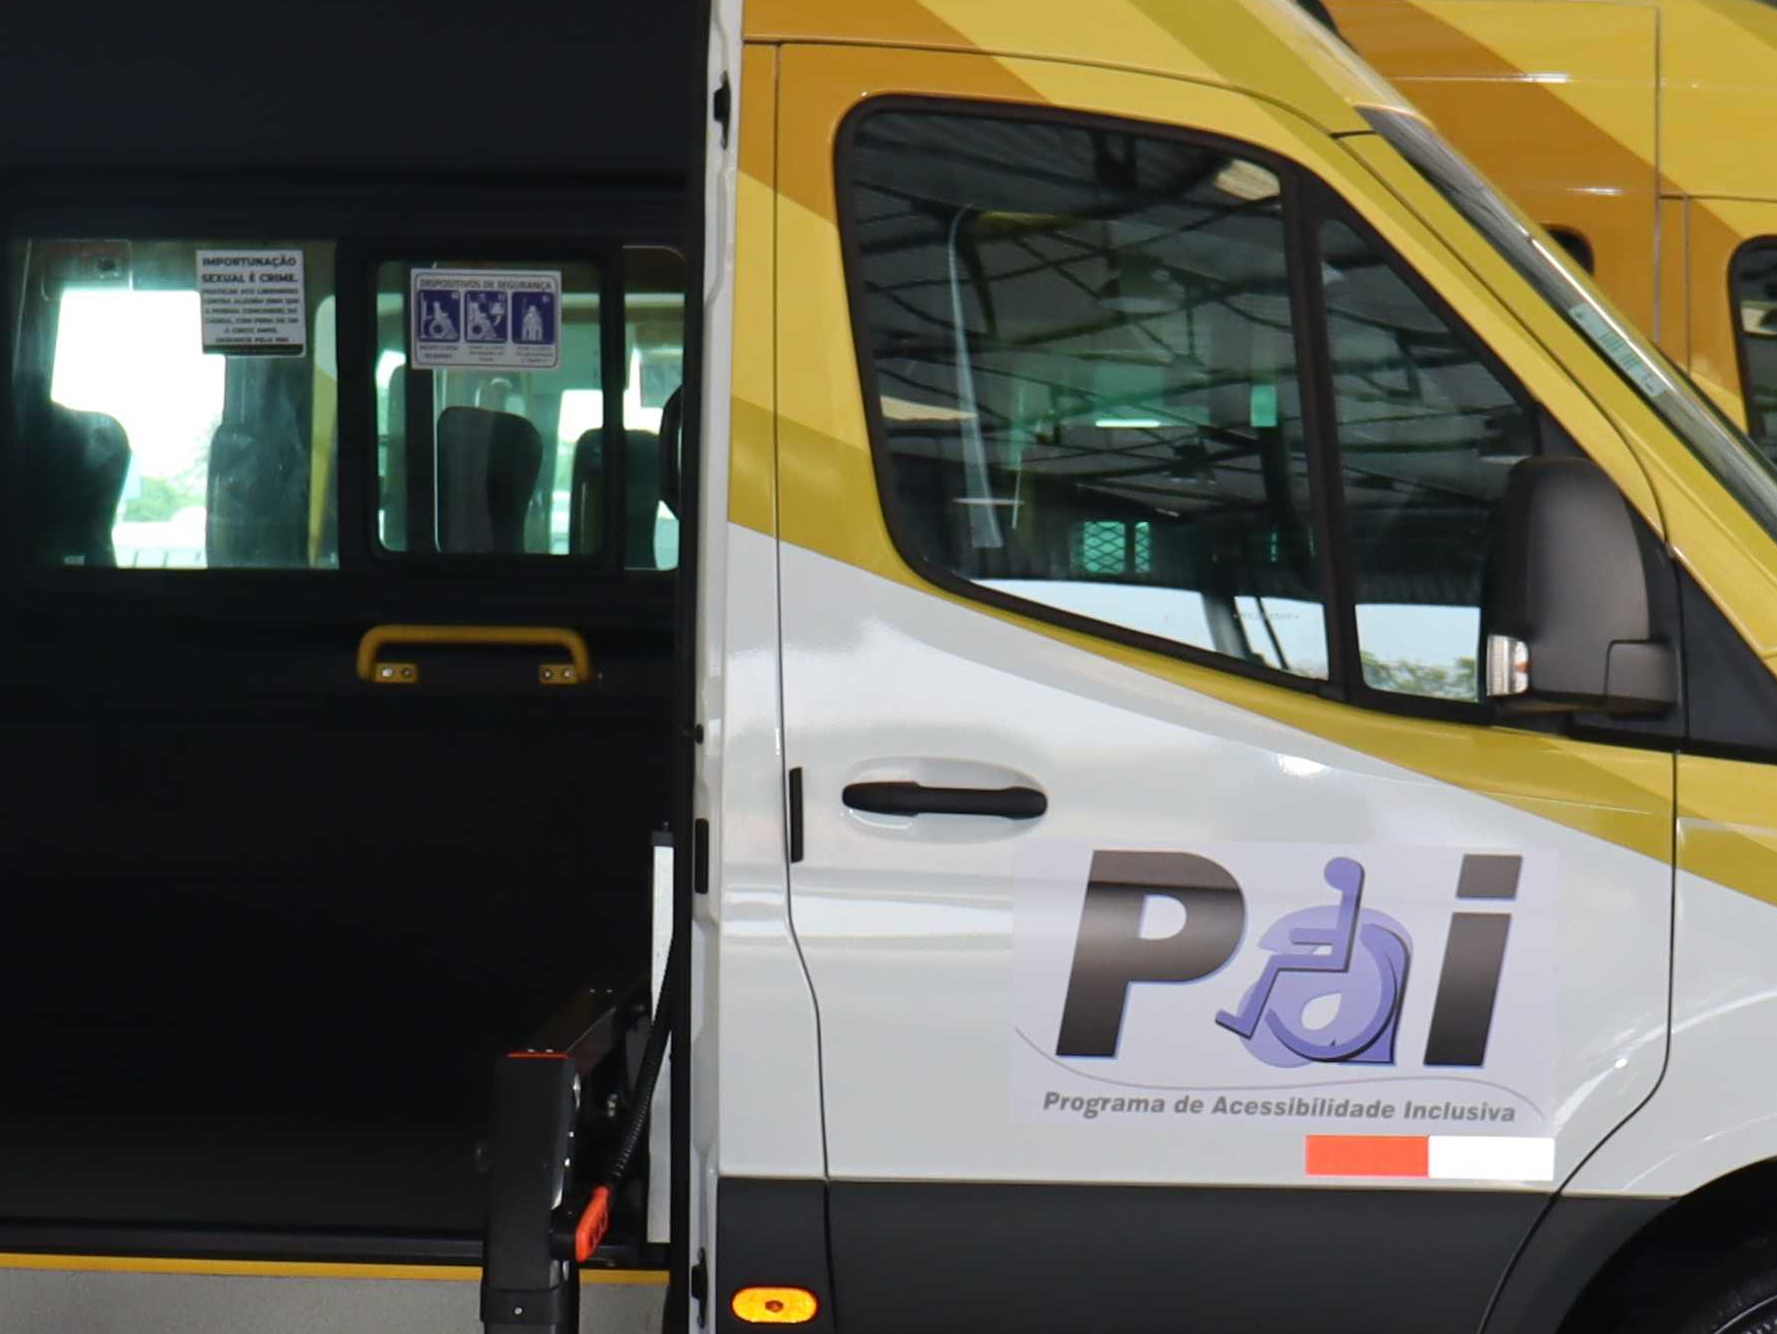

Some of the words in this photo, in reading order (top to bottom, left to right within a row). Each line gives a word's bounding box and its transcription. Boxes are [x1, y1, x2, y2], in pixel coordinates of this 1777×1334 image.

[1043, 1091, 1165, 1119] Programa
[1173, 1095, 1204, 1114] de
[1211, 1096, 1396, 1119] Acessibilidade
[1403, 1100, 1516, 1122] Inclusiva
